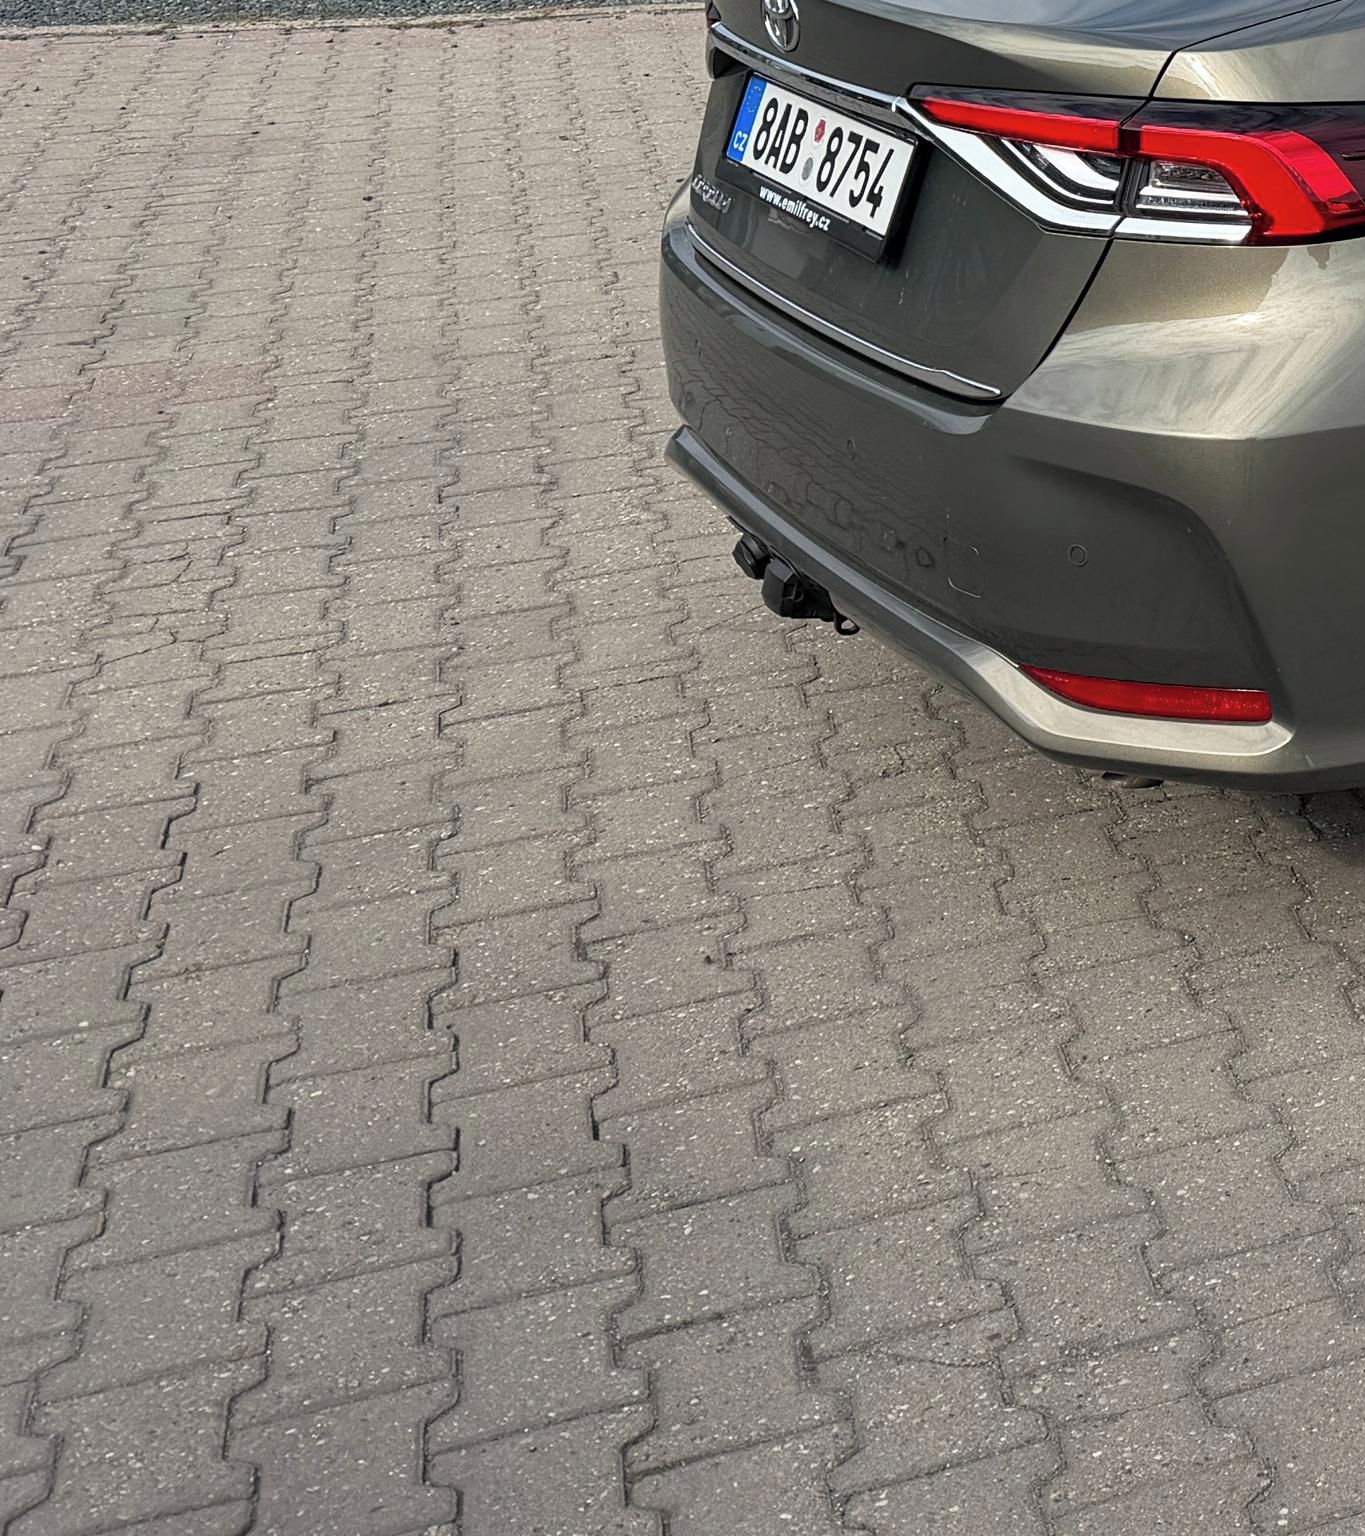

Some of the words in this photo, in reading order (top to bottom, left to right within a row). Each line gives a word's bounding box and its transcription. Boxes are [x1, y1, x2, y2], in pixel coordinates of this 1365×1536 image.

[732, 130, 748, 152] CZ
[753, 97, 809, 174] 8AB
[815, 126, 894, 218] 8754
[758, 184, 831, 232] www.emilfrey.cz
